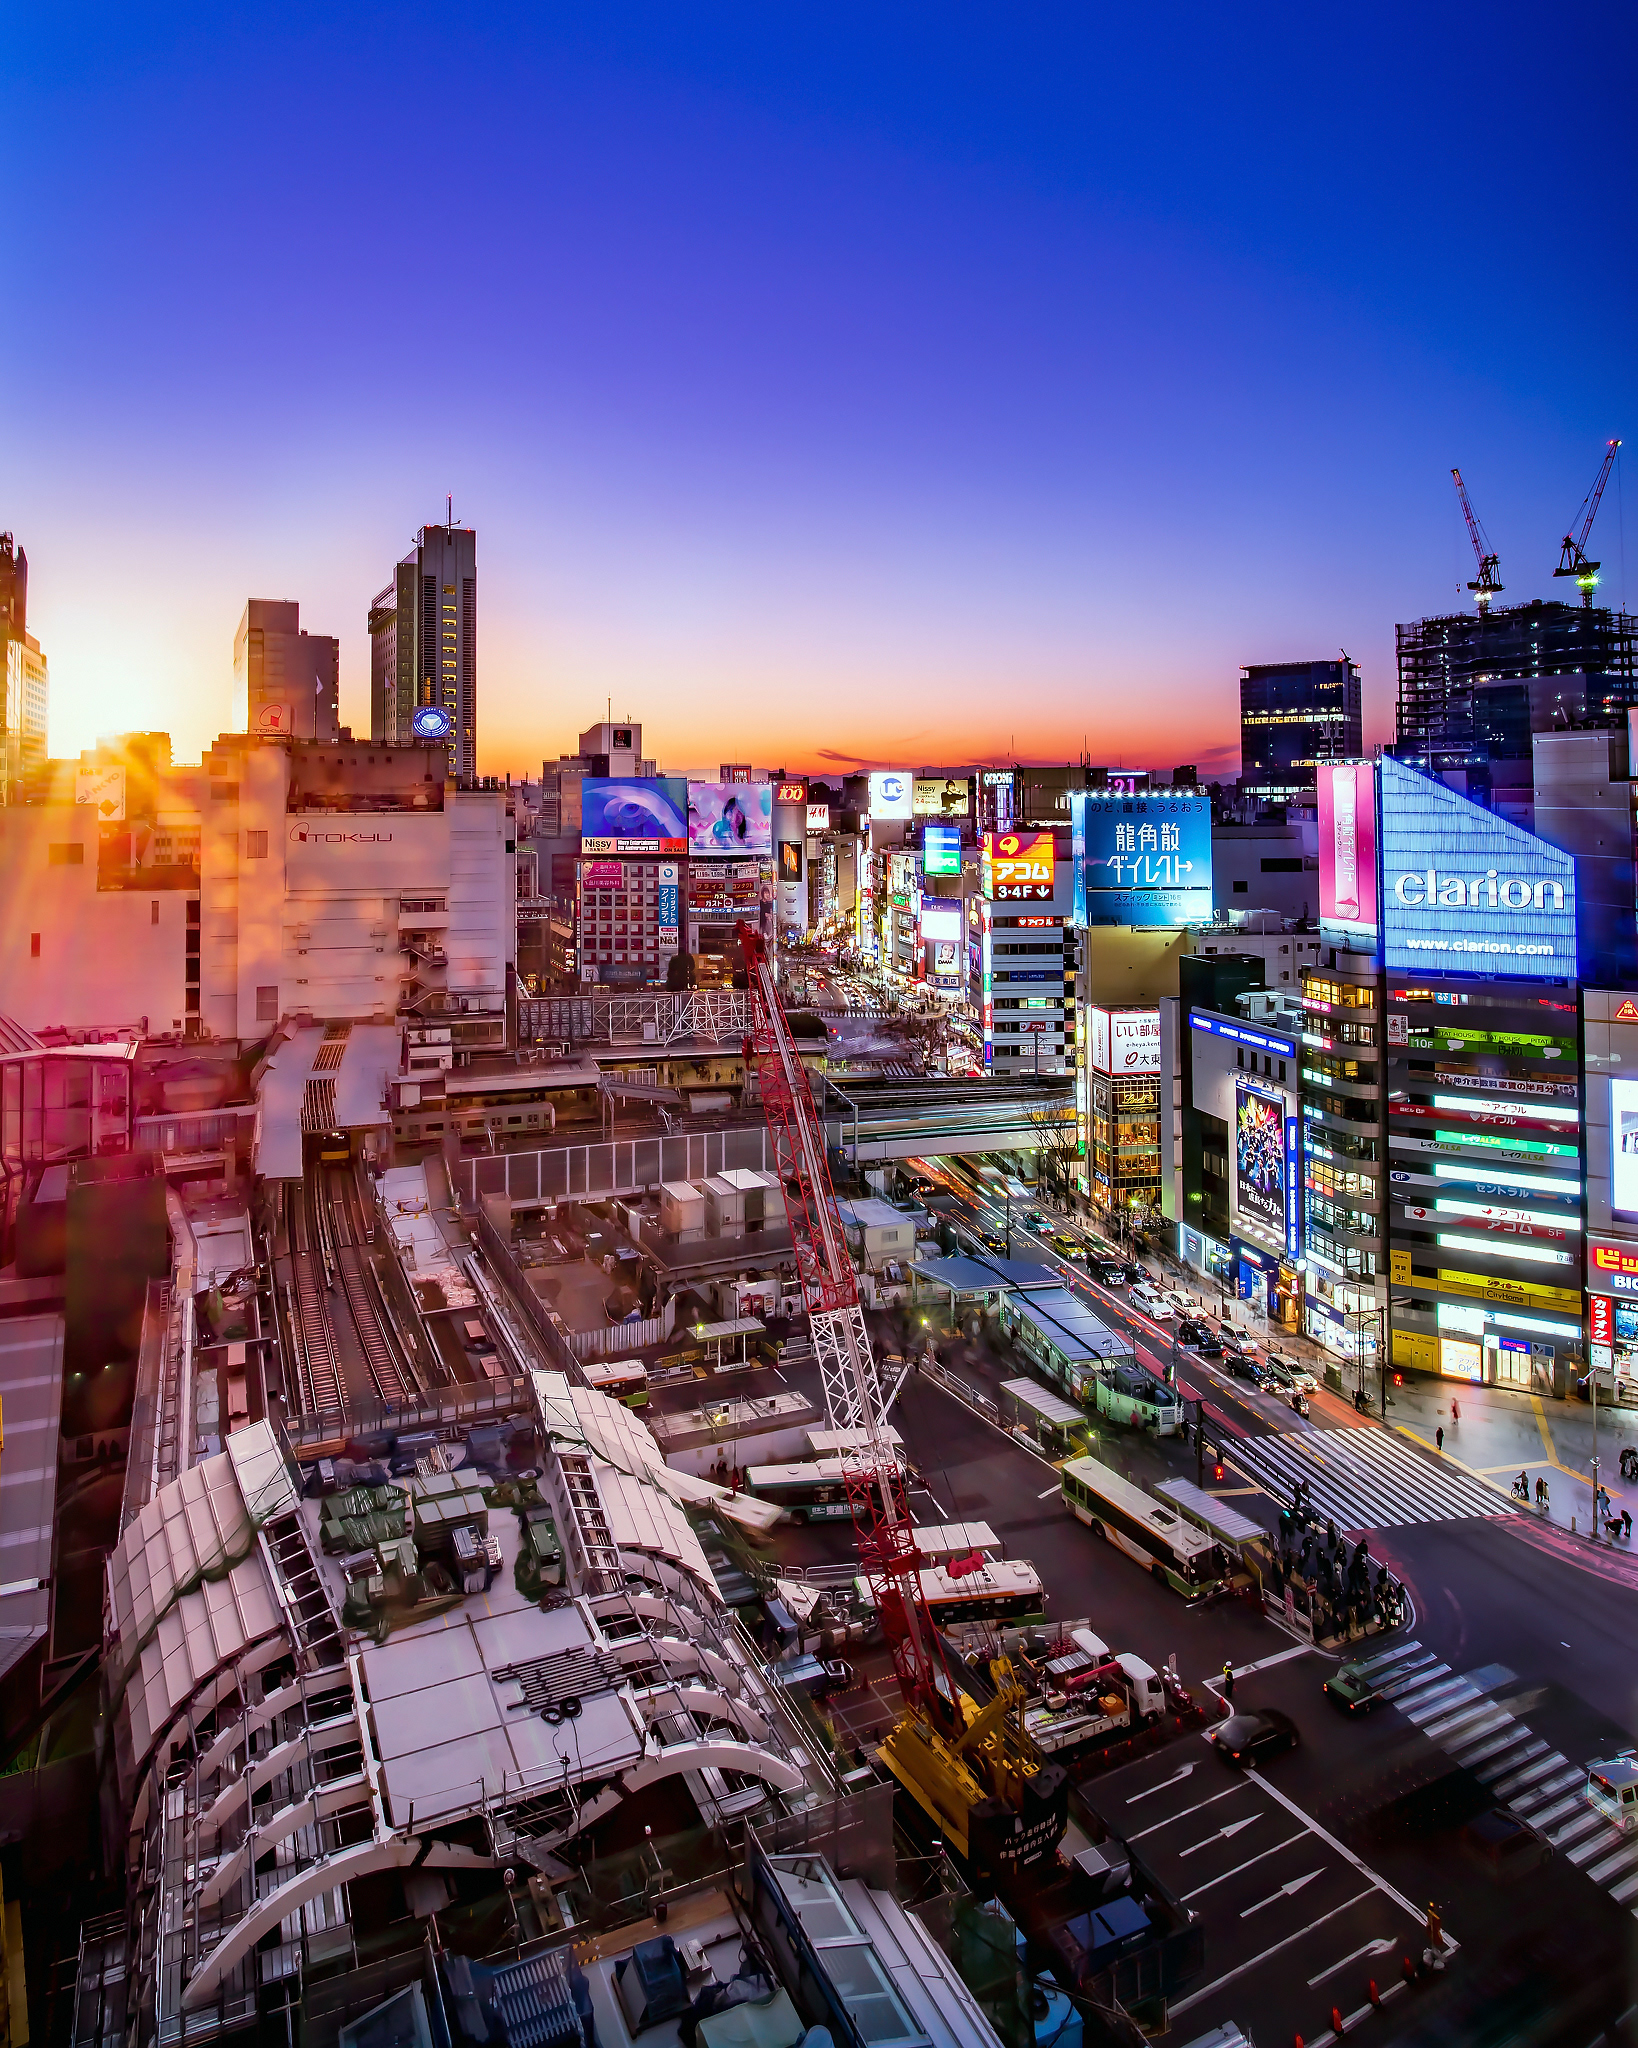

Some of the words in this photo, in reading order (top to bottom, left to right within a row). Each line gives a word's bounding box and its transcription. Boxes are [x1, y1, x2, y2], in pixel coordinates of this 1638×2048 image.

[77, 772, 120, 804] SANKYO
[917, 784, 936, 792] Nissy
[1091, 802, 1204, 814] のど、直接、うるおう
[306, 832, 393, 843] TOKYU
[1115, 822, 1181, 852] 龍角散
[585, 838, 612, 849] Nissy
[996, 862, 1050, 880] アコム
[1106, 855, 1194, 884] ダイレクト
[1394, 868, 1564, 909] clarion
[1114, 893, 1151, 902] スティック
[1027, 917, 1053, 926] アイフル
[1406, 937, 1554, 956] www.clarion.com
[1414, 1038, 1434, 1048] 10F
[1481, 1113, 1517, 1125] アイフル
[1420, 1141, 1462, 1152] レイクALSA
[1545, 1144, 1561, 1154] 7F
[1501, 1150, 1545, 1162] レイクALSA
[1475, 1182, 1530, 1198] セントラル
[1486, 1218, 1533, 1235] アコム
[1548, 1228, 1563, 1237] 5F
[1487, 1278, 1525, 1291] シティホーム
[1486, 1290, 1524, 1303] CityHome
[1594, 1299, 1608, 1339] カラオケ
[1458, 1363, 1473, 1373] OK
